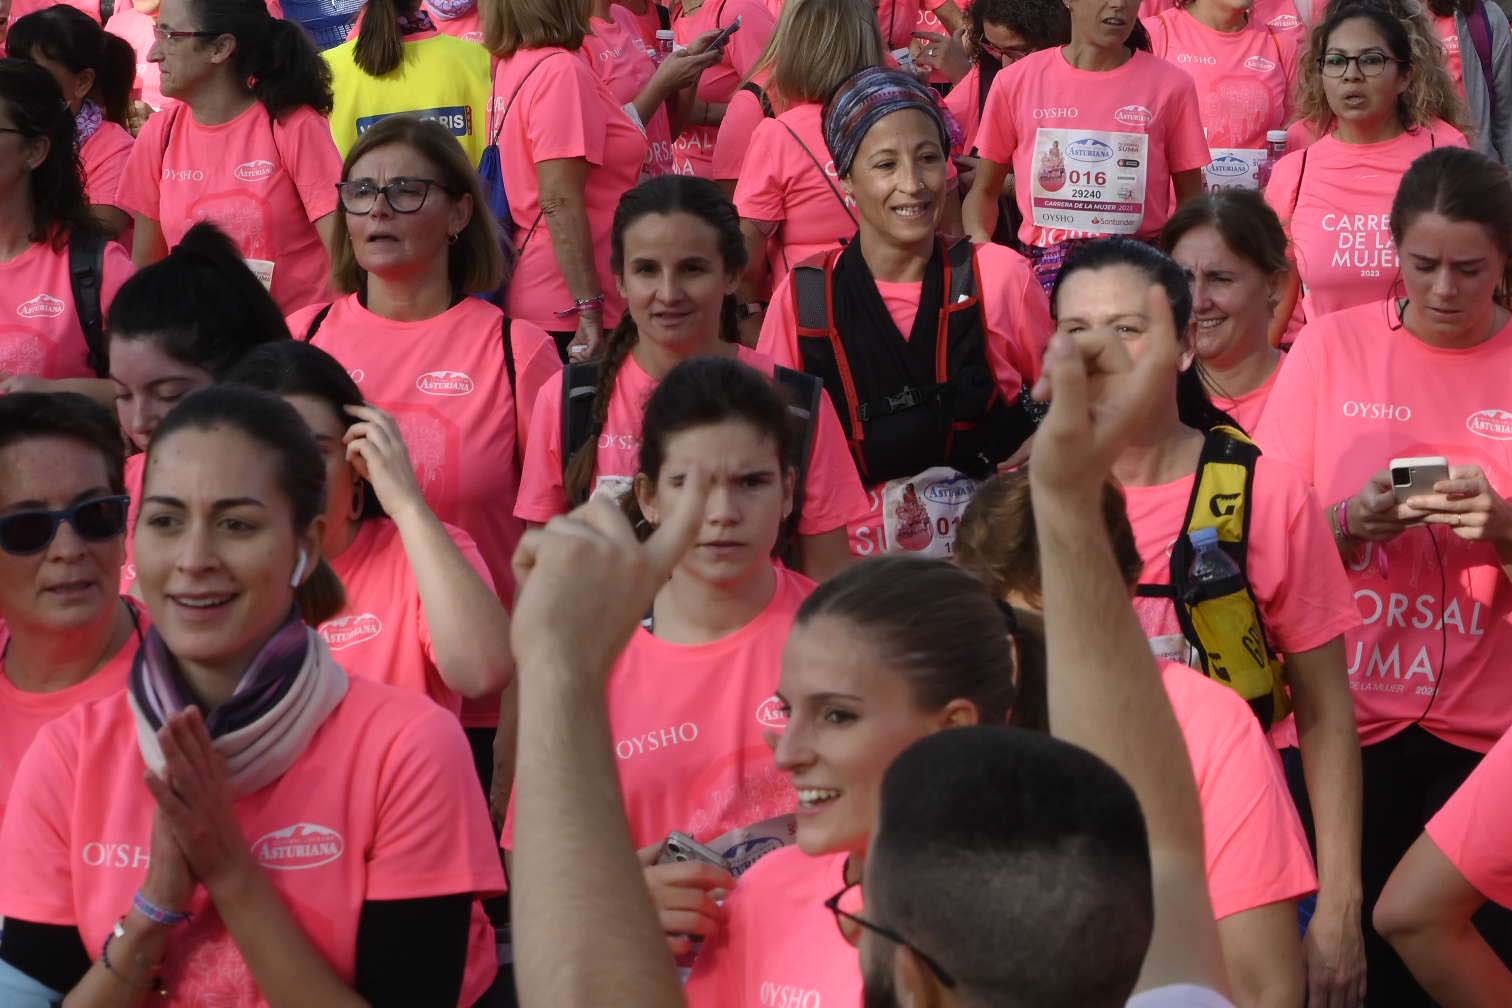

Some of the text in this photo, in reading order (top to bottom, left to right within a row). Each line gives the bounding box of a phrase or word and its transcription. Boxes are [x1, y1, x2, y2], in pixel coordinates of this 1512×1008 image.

[1177, 53, 1216, 65] OYSHO
[1032, 107, 1078, 119] OYSHO
[1070, 147, 1110, 158] ASTURIANA
[1069, 170, 1107, 185] 016
[1071, 189, 1102, 199] 29240
[1044, 200, 1073, 209] CARRERA
[1095, 203, 1117, 211] MUJER
[1042, 213, 1075, 224] OYSHO
[1099, 217, 1136, 226] Santander
[1321, 213, 1392, 231] CARRE
[1338, 232, 1367, 250] DE
[420, 376, 470, 392] ASTURIANA
[1343, 401, 1411, 422] OYSHO
[1353, 588, 1485, 635] ORSAL
[616, 722, 698, 760] OYSHO
[83, 841, 150, 869] OYSH
[259, 841, 338, 860] ASTURIANA
